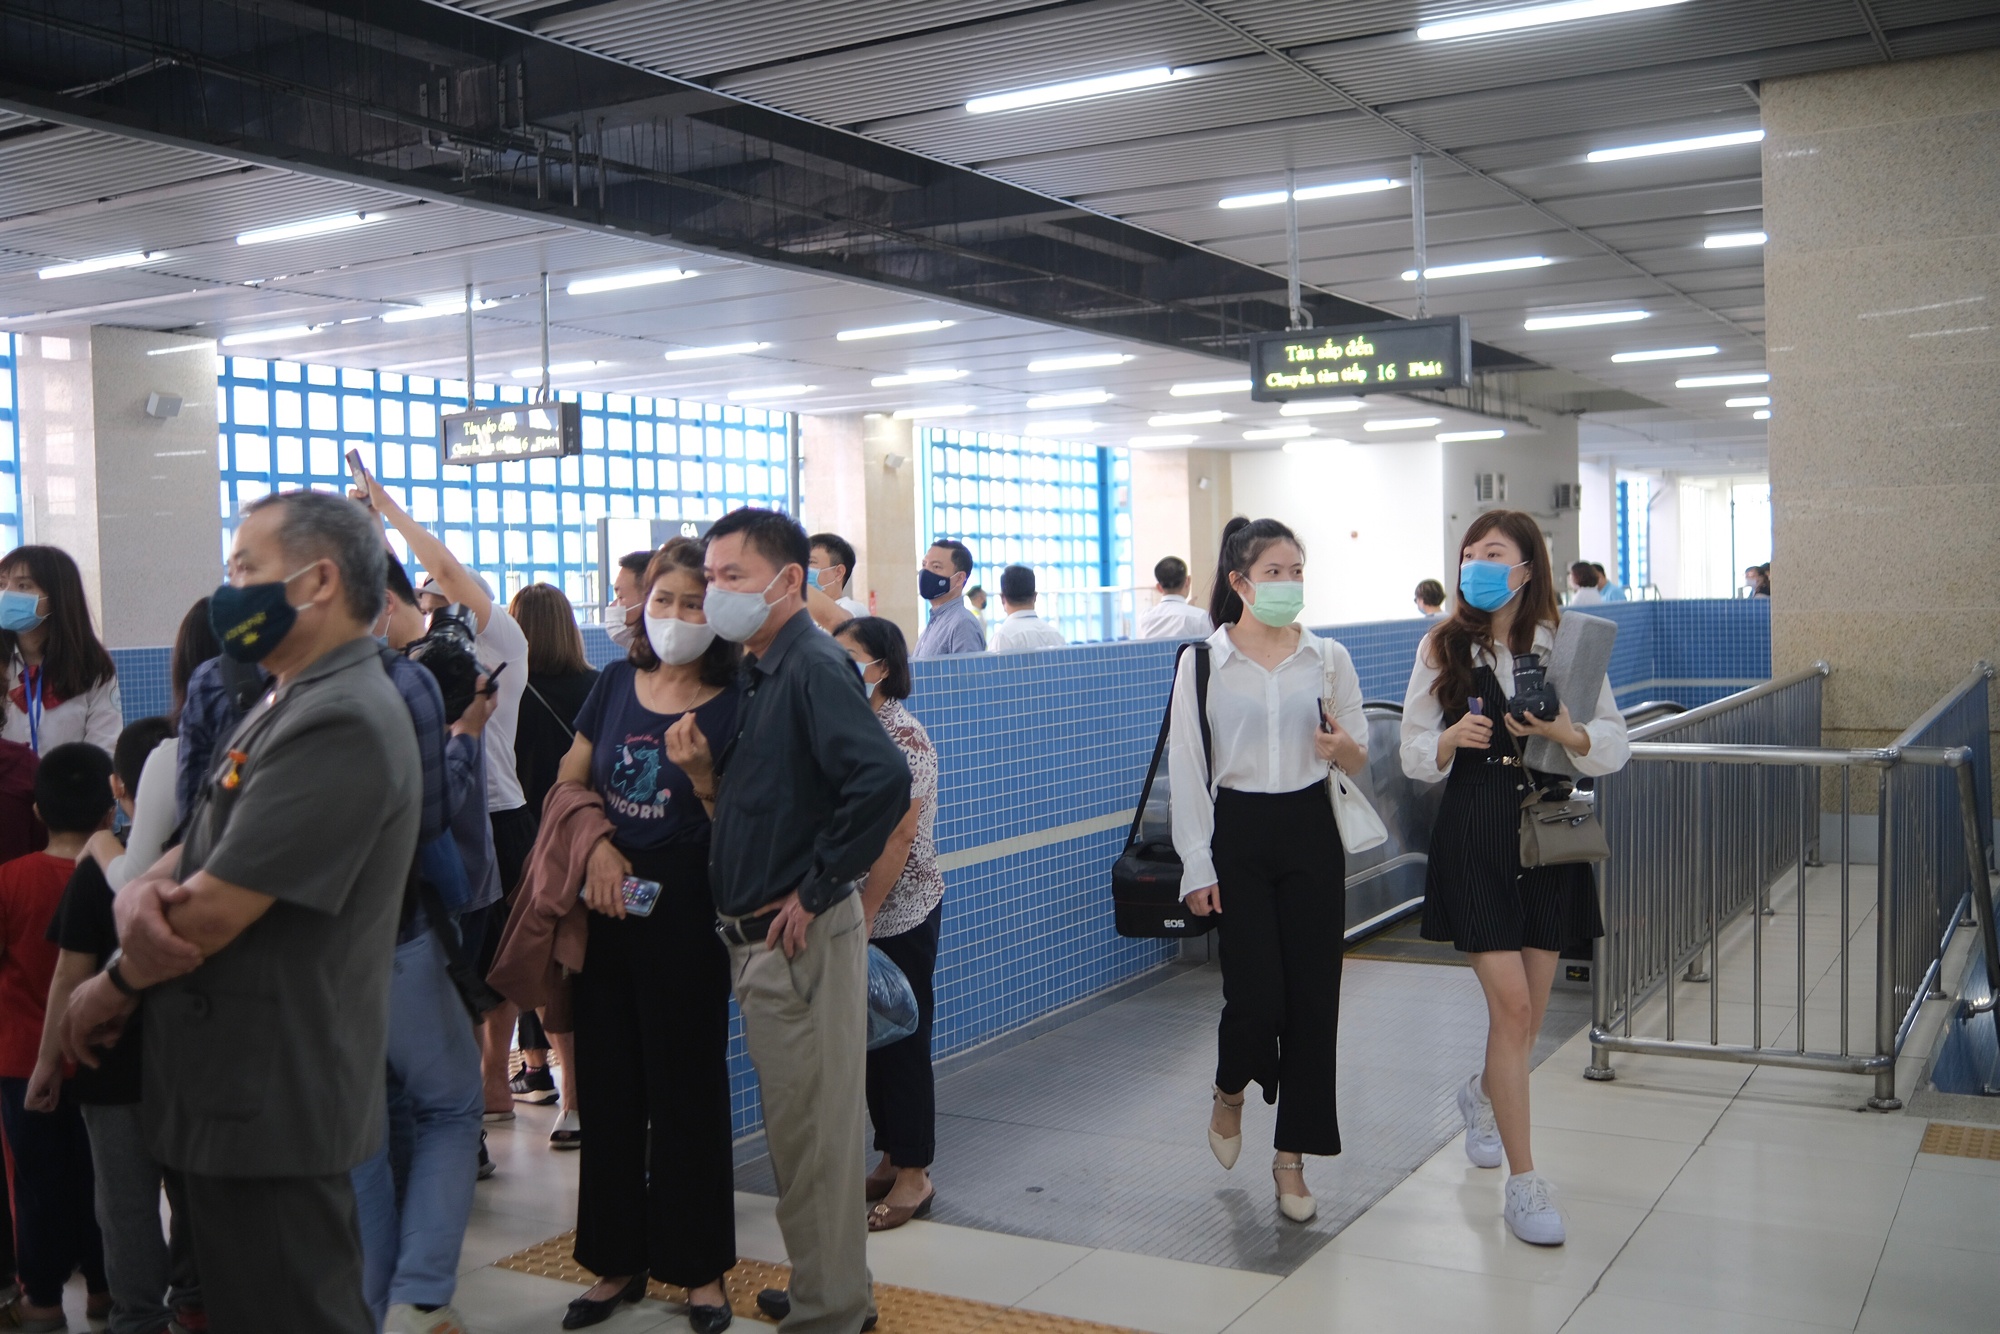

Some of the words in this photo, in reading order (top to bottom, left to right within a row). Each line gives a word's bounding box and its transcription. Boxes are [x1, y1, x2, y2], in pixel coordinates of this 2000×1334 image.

[1285, 344, 1315, 361] Tàu
[1345, 335, 1374, 357] đến
[1377, 363, 1396, 381] 16
[1408, 361, 1442, 377] Phút
[1163, 919, 1186, 928] EOS
